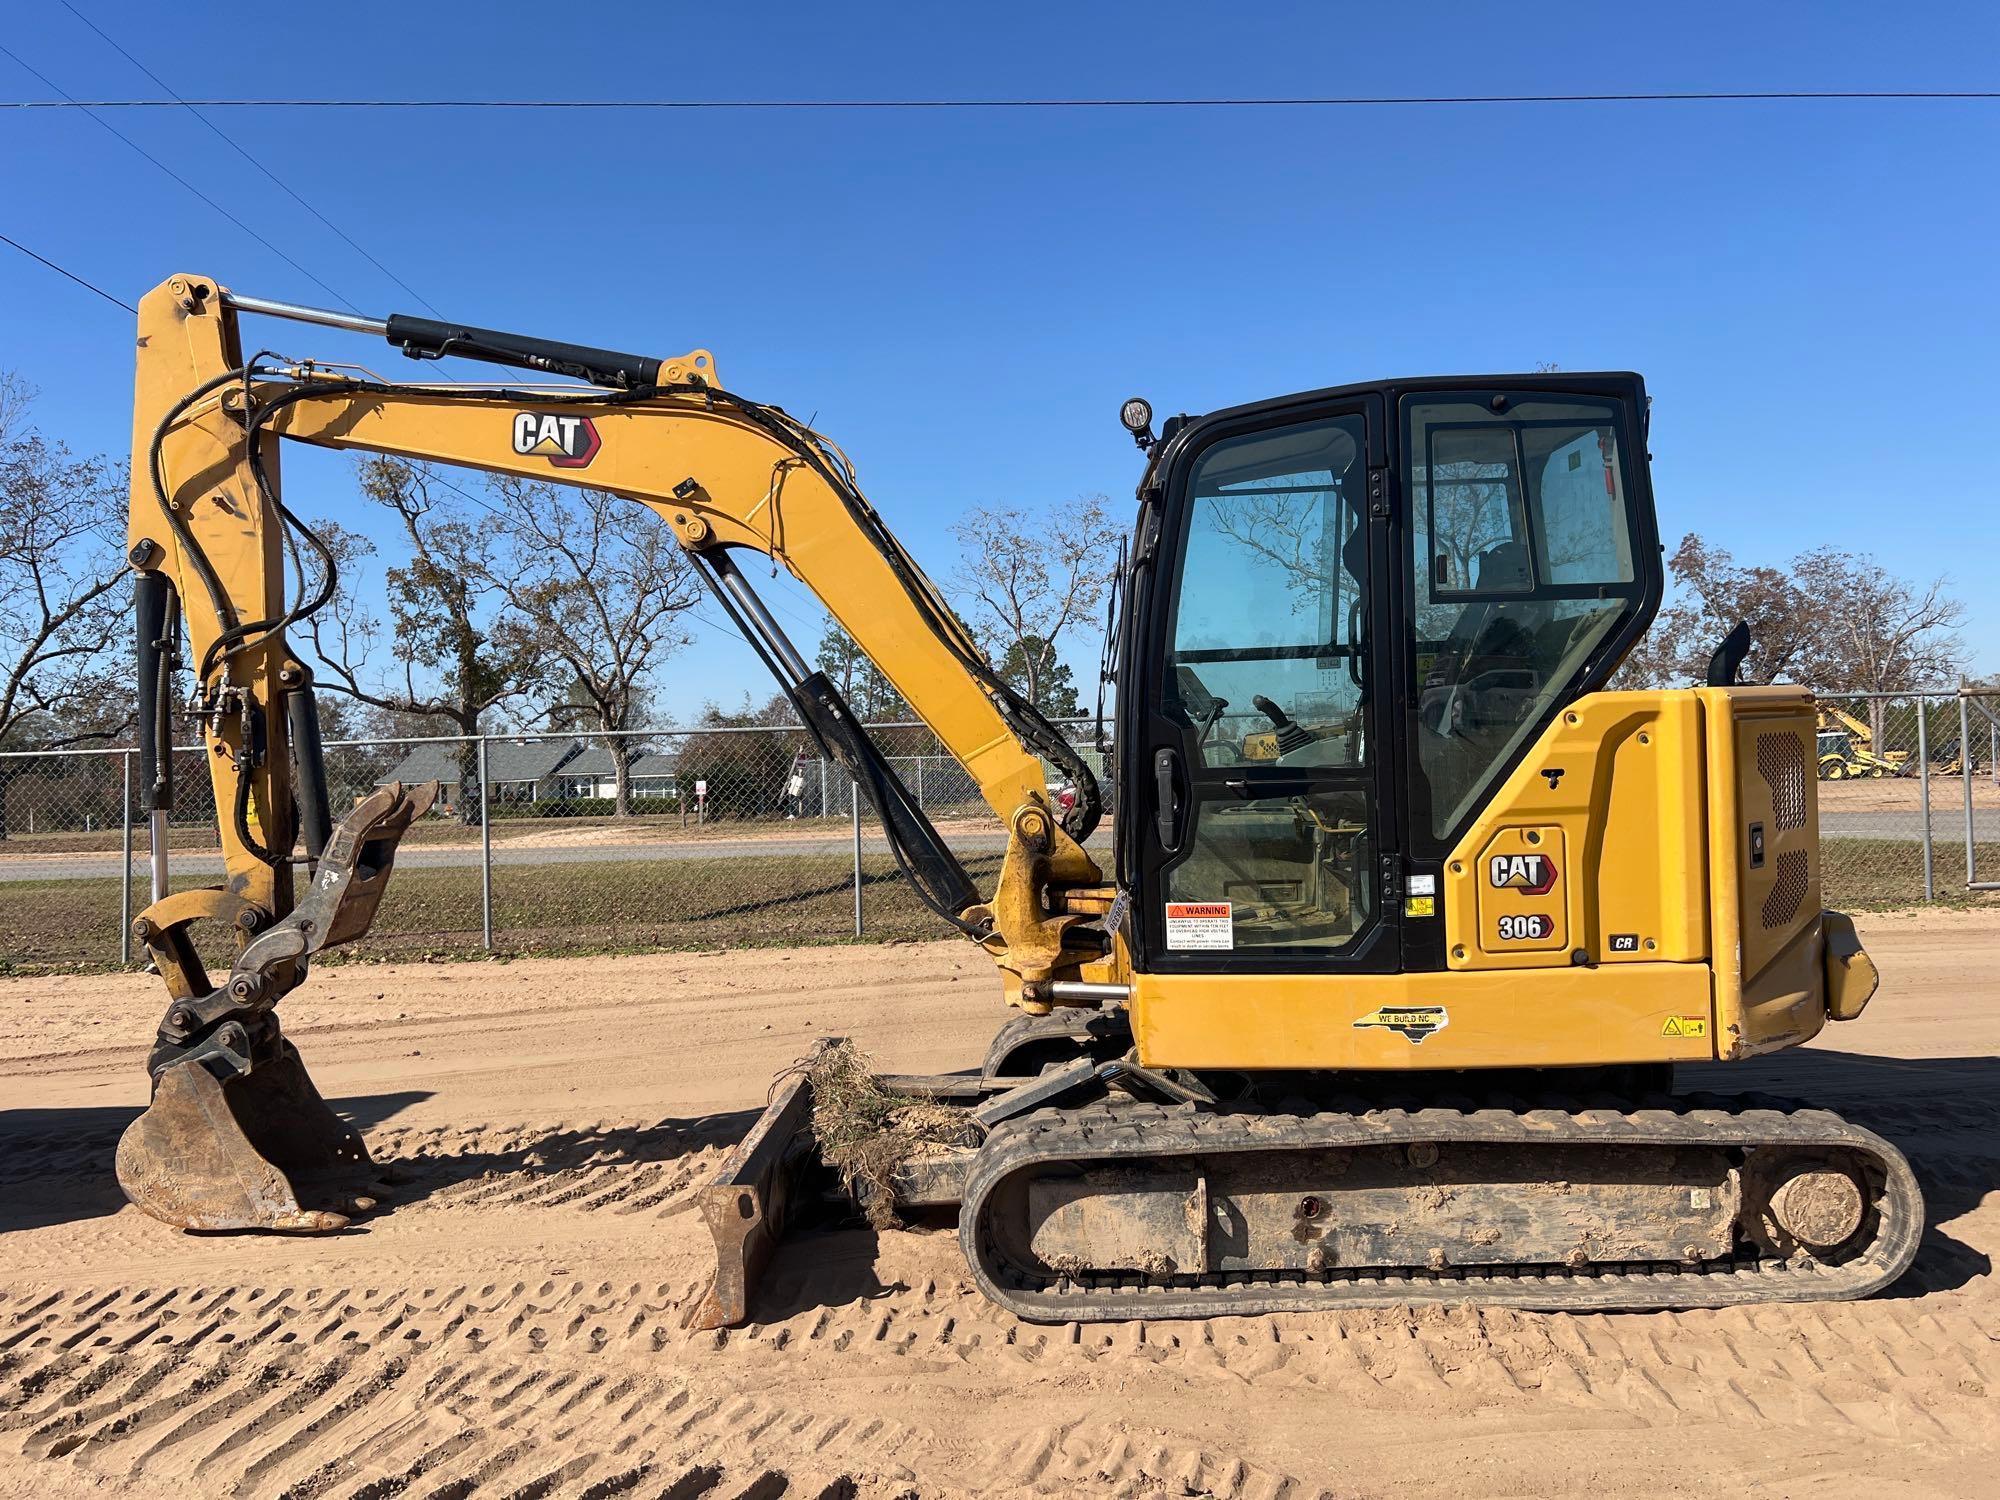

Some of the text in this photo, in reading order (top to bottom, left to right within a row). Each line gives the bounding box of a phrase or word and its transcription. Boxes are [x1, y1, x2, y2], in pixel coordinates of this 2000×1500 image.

[514, 413, 581, 456] CAT
[1491, 856, 1541, 887] CAT
[1186, 906, 1227, 915] WARNING
[1499, 915, 1541, 939] 306
[1615, 937, 1633, 949] CR
[1378, 1014, 1430, 1023] WE BUILD NC
